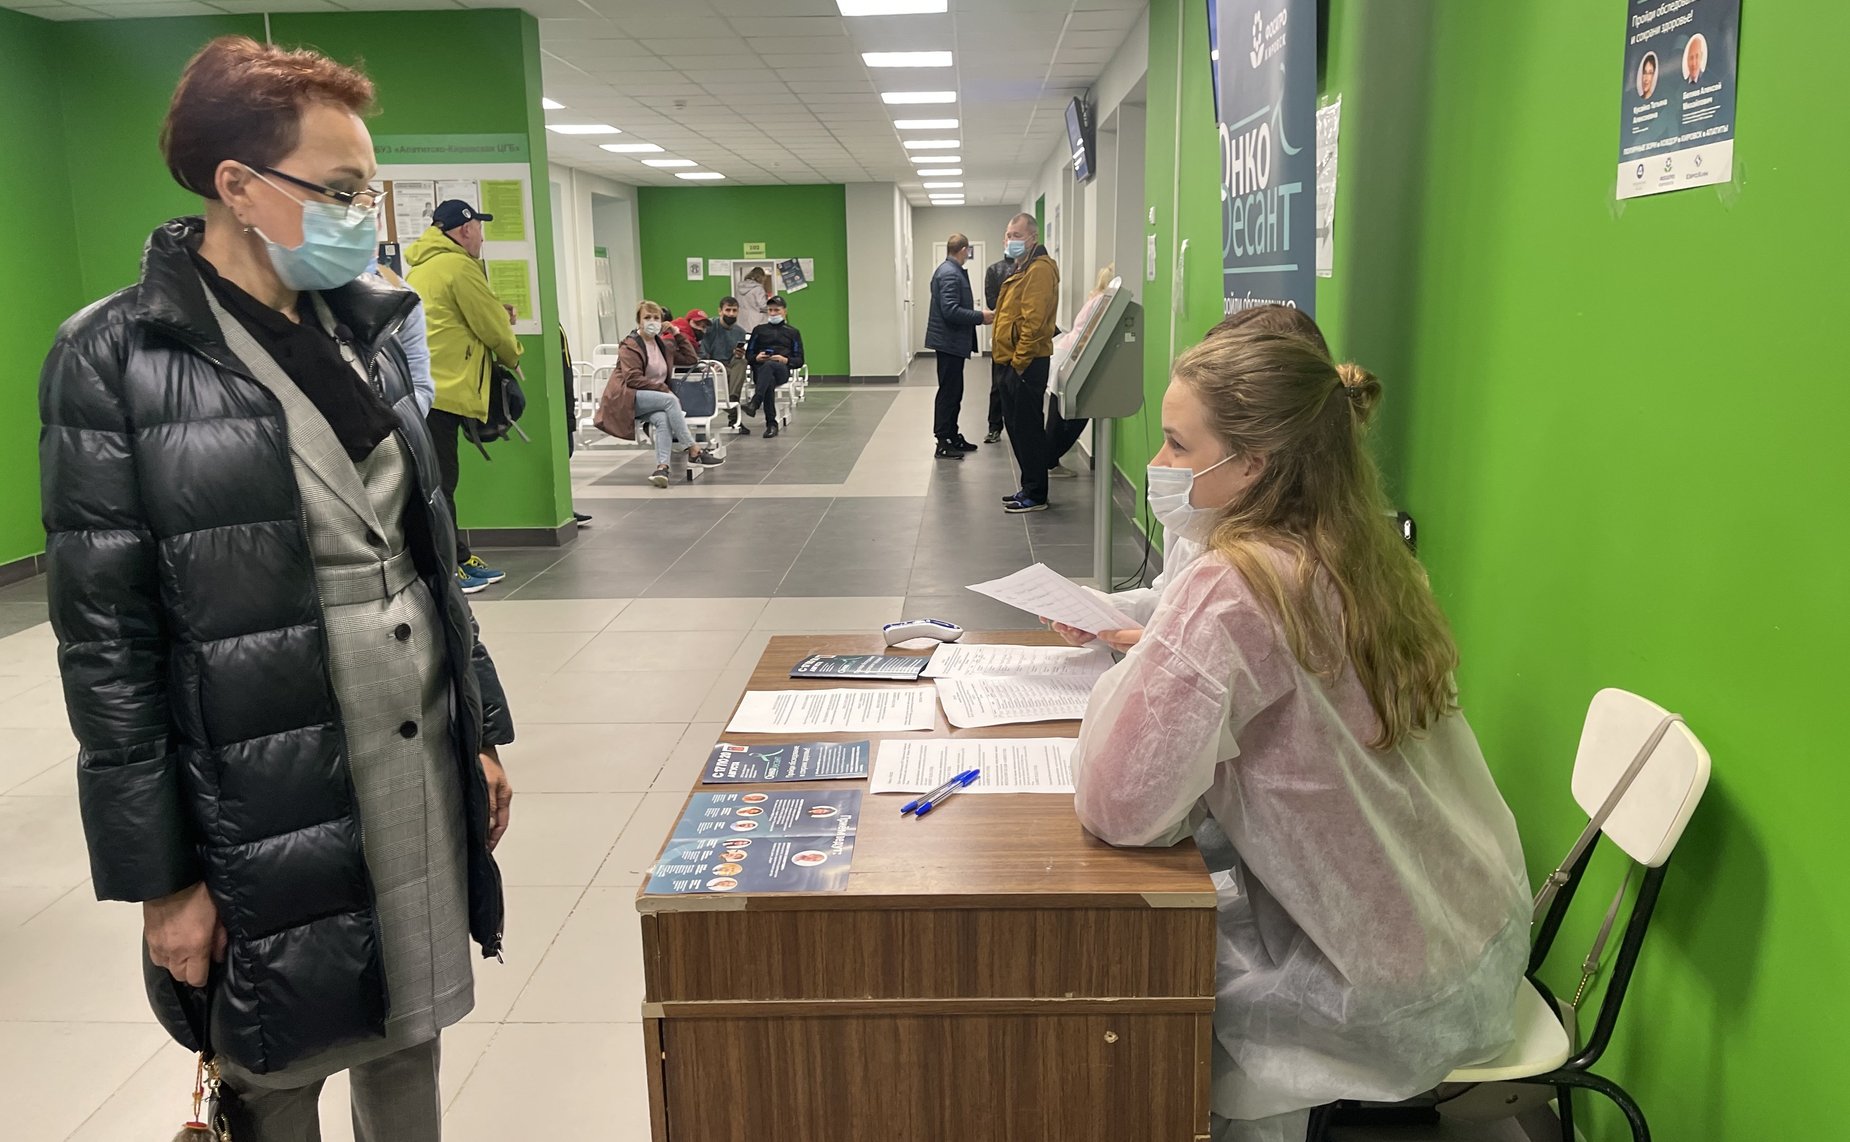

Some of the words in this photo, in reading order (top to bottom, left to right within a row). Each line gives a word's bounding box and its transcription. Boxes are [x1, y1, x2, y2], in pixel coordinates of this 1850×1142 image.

[1631, 35, 1636, 45] и
[1636, 25, 1661, 42] сохрани
[1661, 9, 1694, 33] здоровье!
[1632, 10, 1656, 28] Пройди
